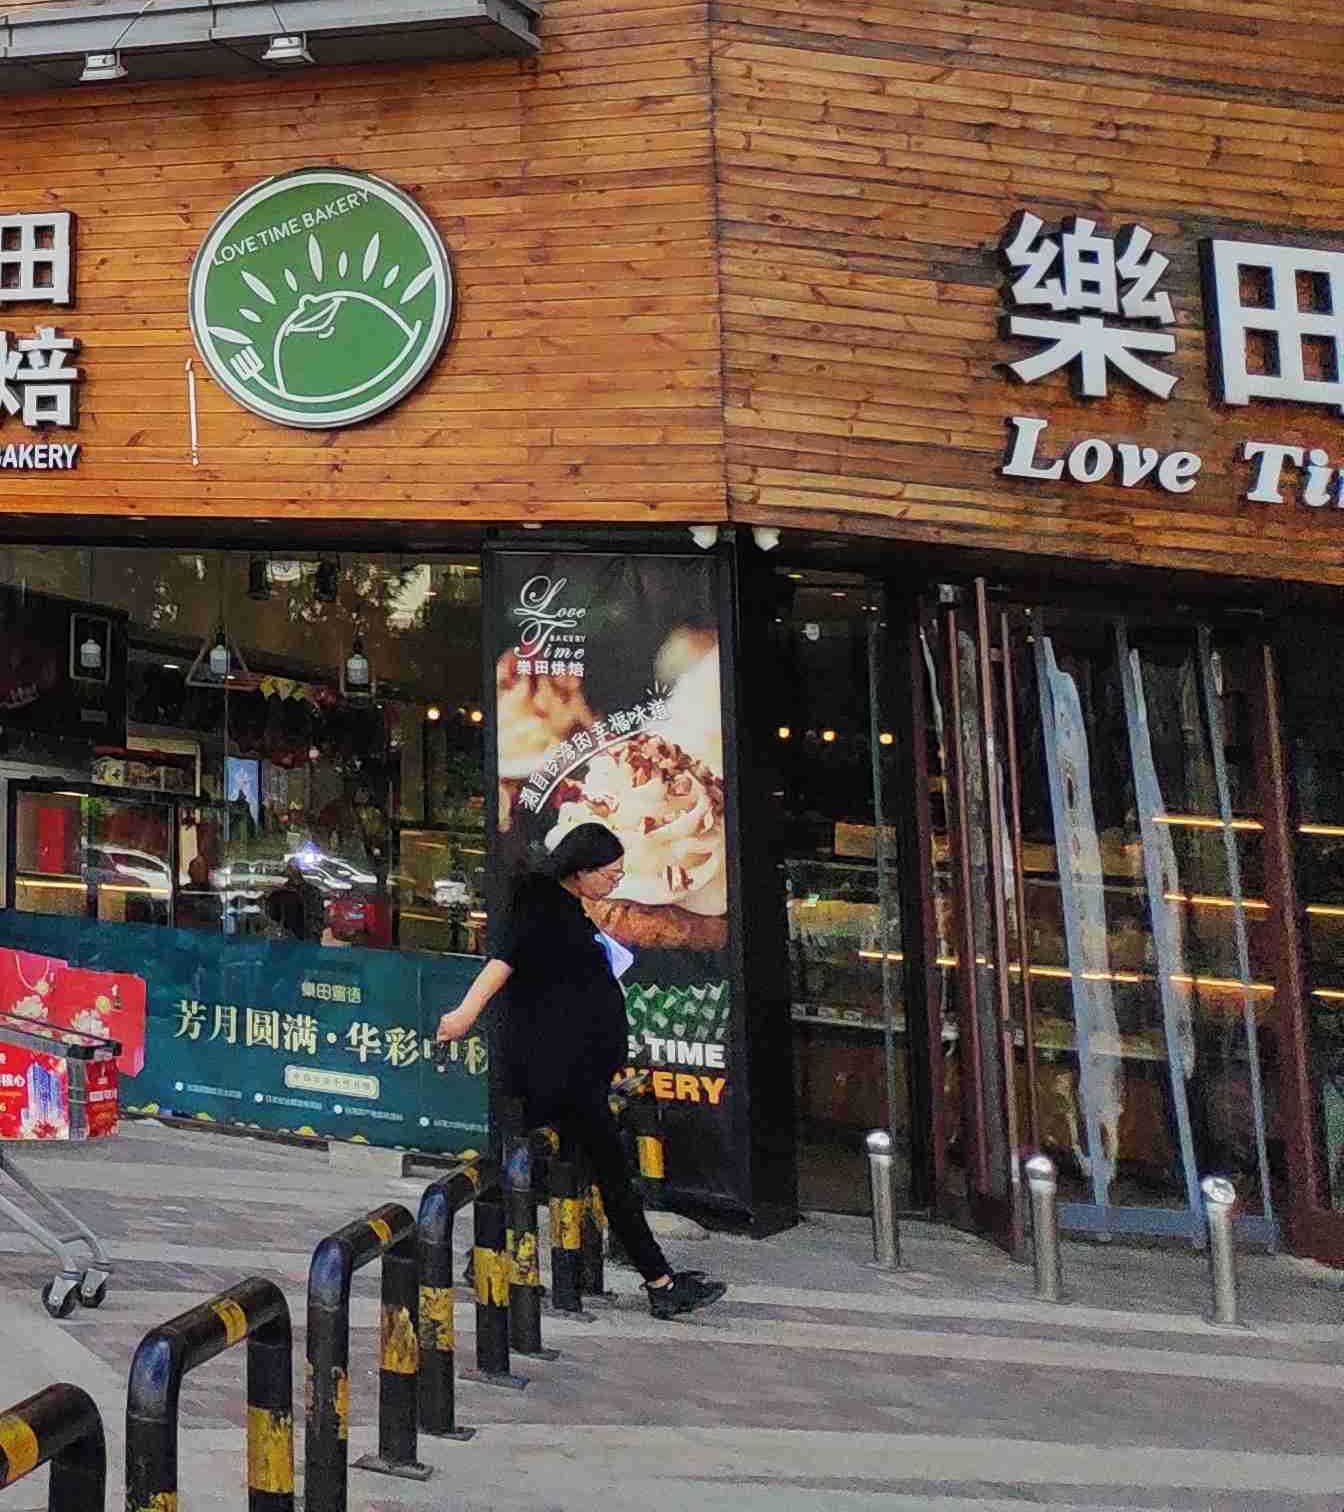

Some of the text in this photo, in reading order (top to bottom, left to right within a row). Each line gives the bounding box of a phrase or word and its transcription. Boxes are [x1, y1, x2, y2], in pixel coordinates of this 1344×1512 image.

[213, 189, 370, 266] LOVE TIME BAKERY
[1002, 416, 1344, 509] Love Ti
[513, 575, 586, 620] Love
[513, 618, 585, 658] Time
[644, 1037, 726, 1068] TIME
